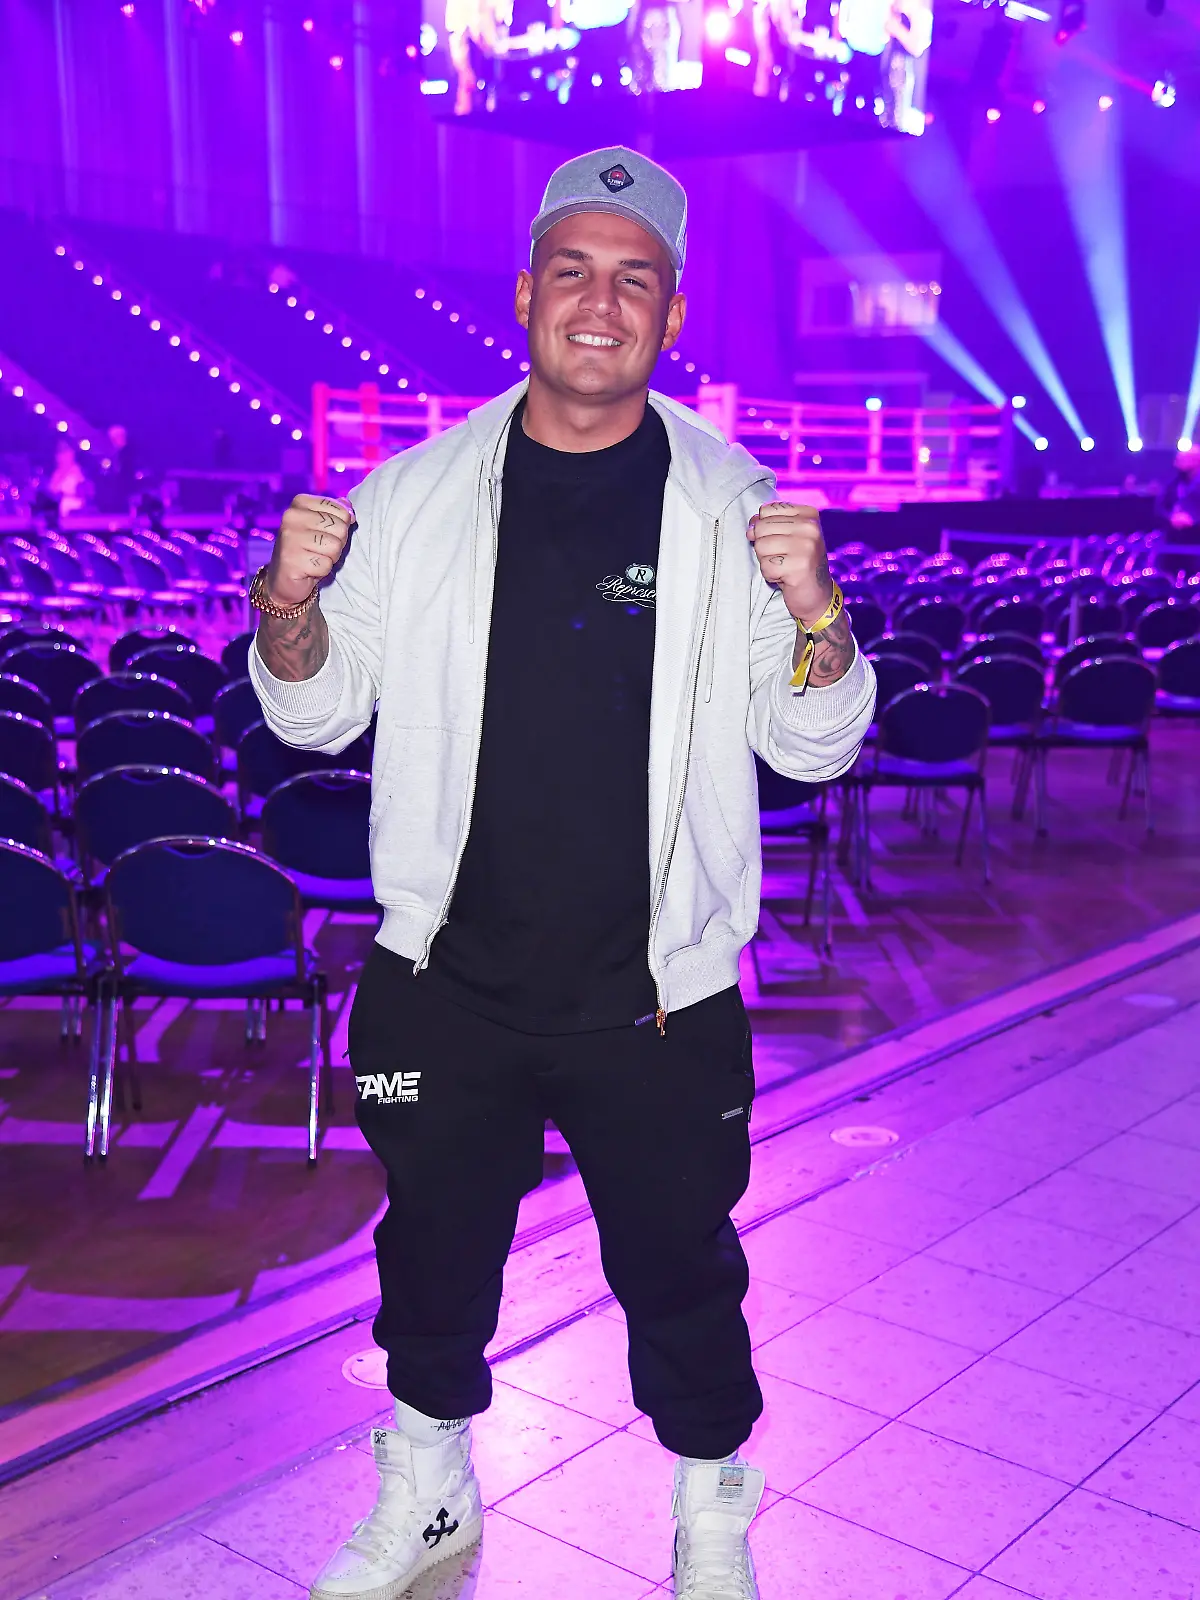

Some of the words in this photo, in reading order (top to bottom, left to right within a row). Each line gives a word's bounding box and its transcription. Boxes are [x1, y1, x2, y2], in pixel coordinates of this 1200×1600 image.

[634, 568, 647, 582] R
[825, 593, 841, 619] VIP
[377, 1095, 419, 1105] FIGHTING
